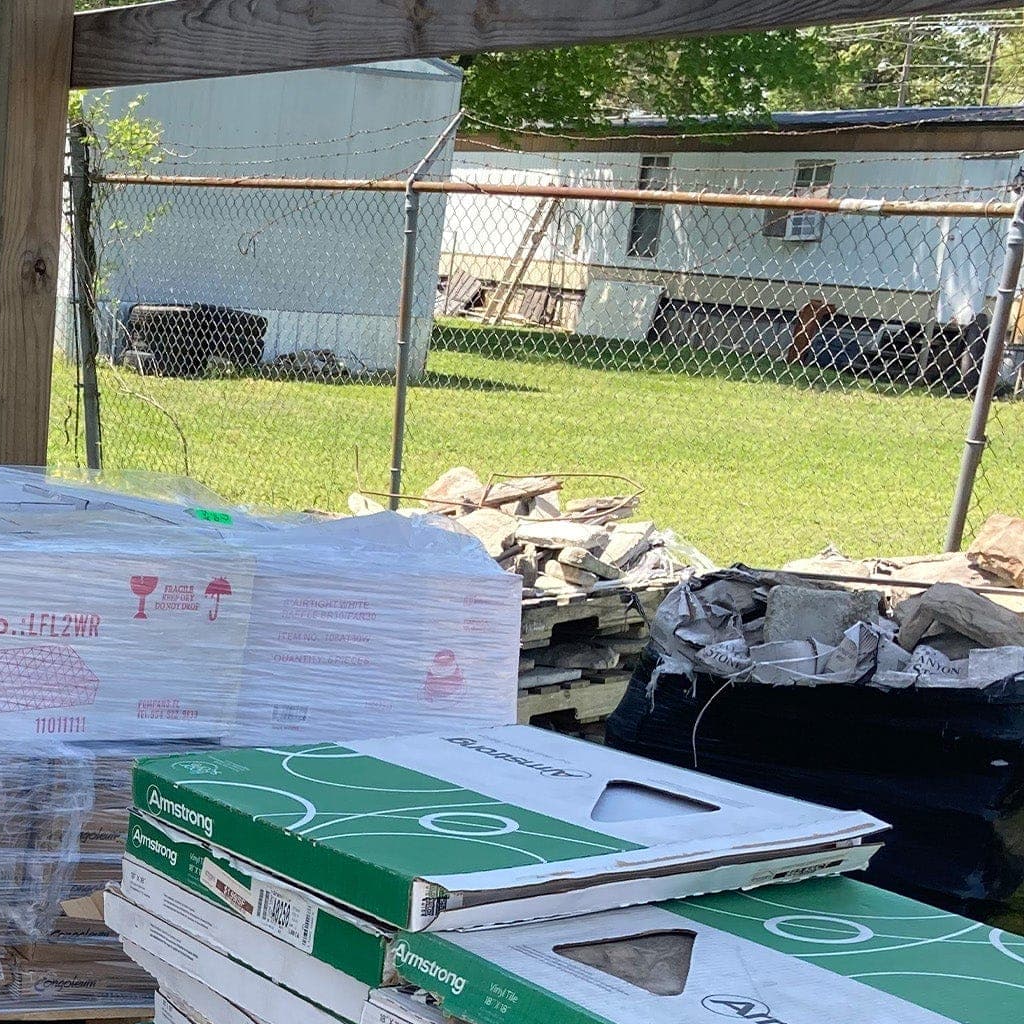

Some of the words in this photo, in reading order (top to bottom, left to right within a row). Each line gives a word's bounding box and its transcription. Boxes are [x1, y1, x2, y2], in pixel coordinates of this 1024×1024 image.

[148, 786, 213, 838] Armstrong
[133, 827, 178, 866] Armstrong
[394, 942, 467, 996] Armstrong
[489, 983, 506, 998] Vinyl
[506, 988, 519, 1003] Tile
